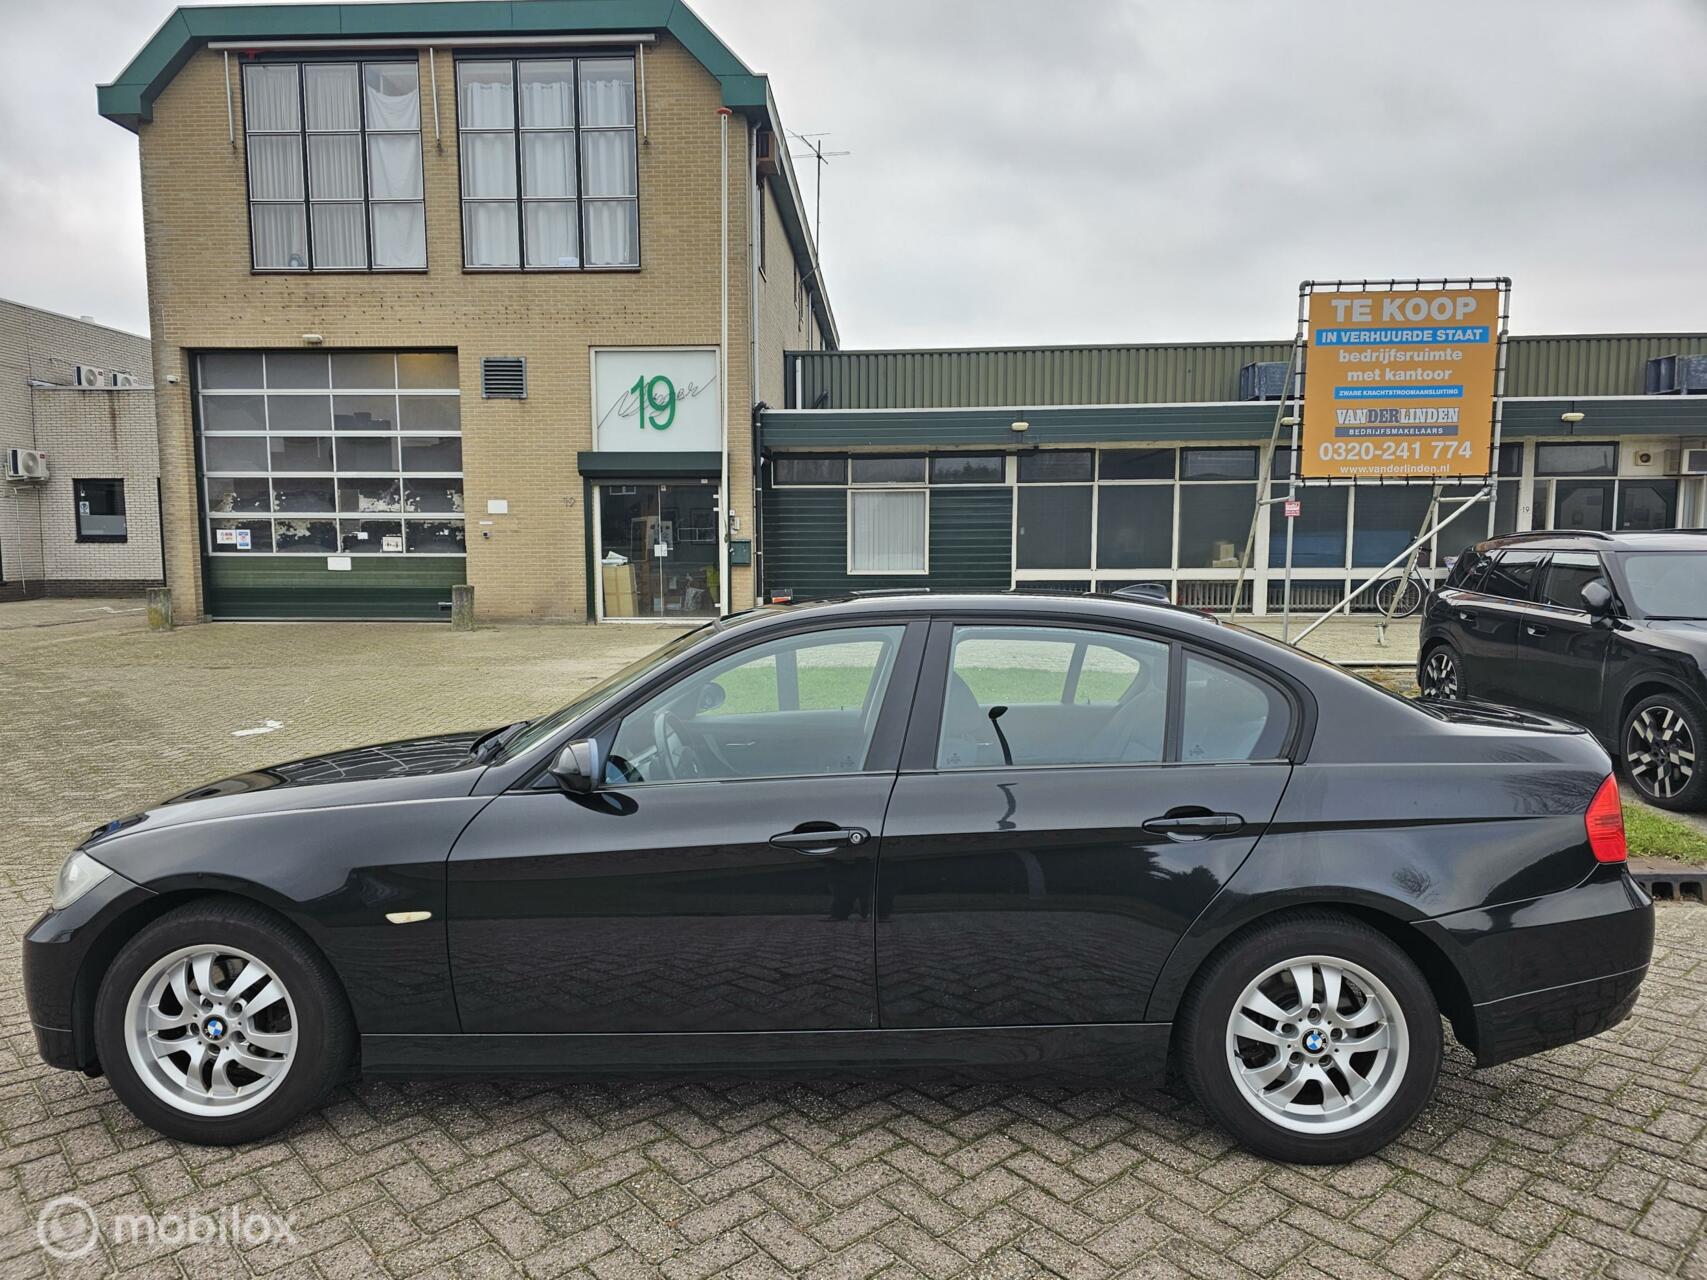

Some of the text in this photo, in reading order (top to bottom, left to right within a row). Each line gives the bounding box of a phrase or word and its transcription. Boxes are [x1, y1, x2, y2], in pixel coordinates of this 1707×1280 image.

[1331, 297, 1477, 322] TE KOOP
[1322, 329, 1483, 343] IN VERHUURDE STAAT
[1339, 348, 1463, 364] bedrijfsruimte
[1347, 367, 1452, 381] met kantoor
[630, 375, 676, 430] 19
[1319, 440, 1473, 461] 0320-241 774
[1340, 463, 1450, 473] www.vanderlinden.nl
